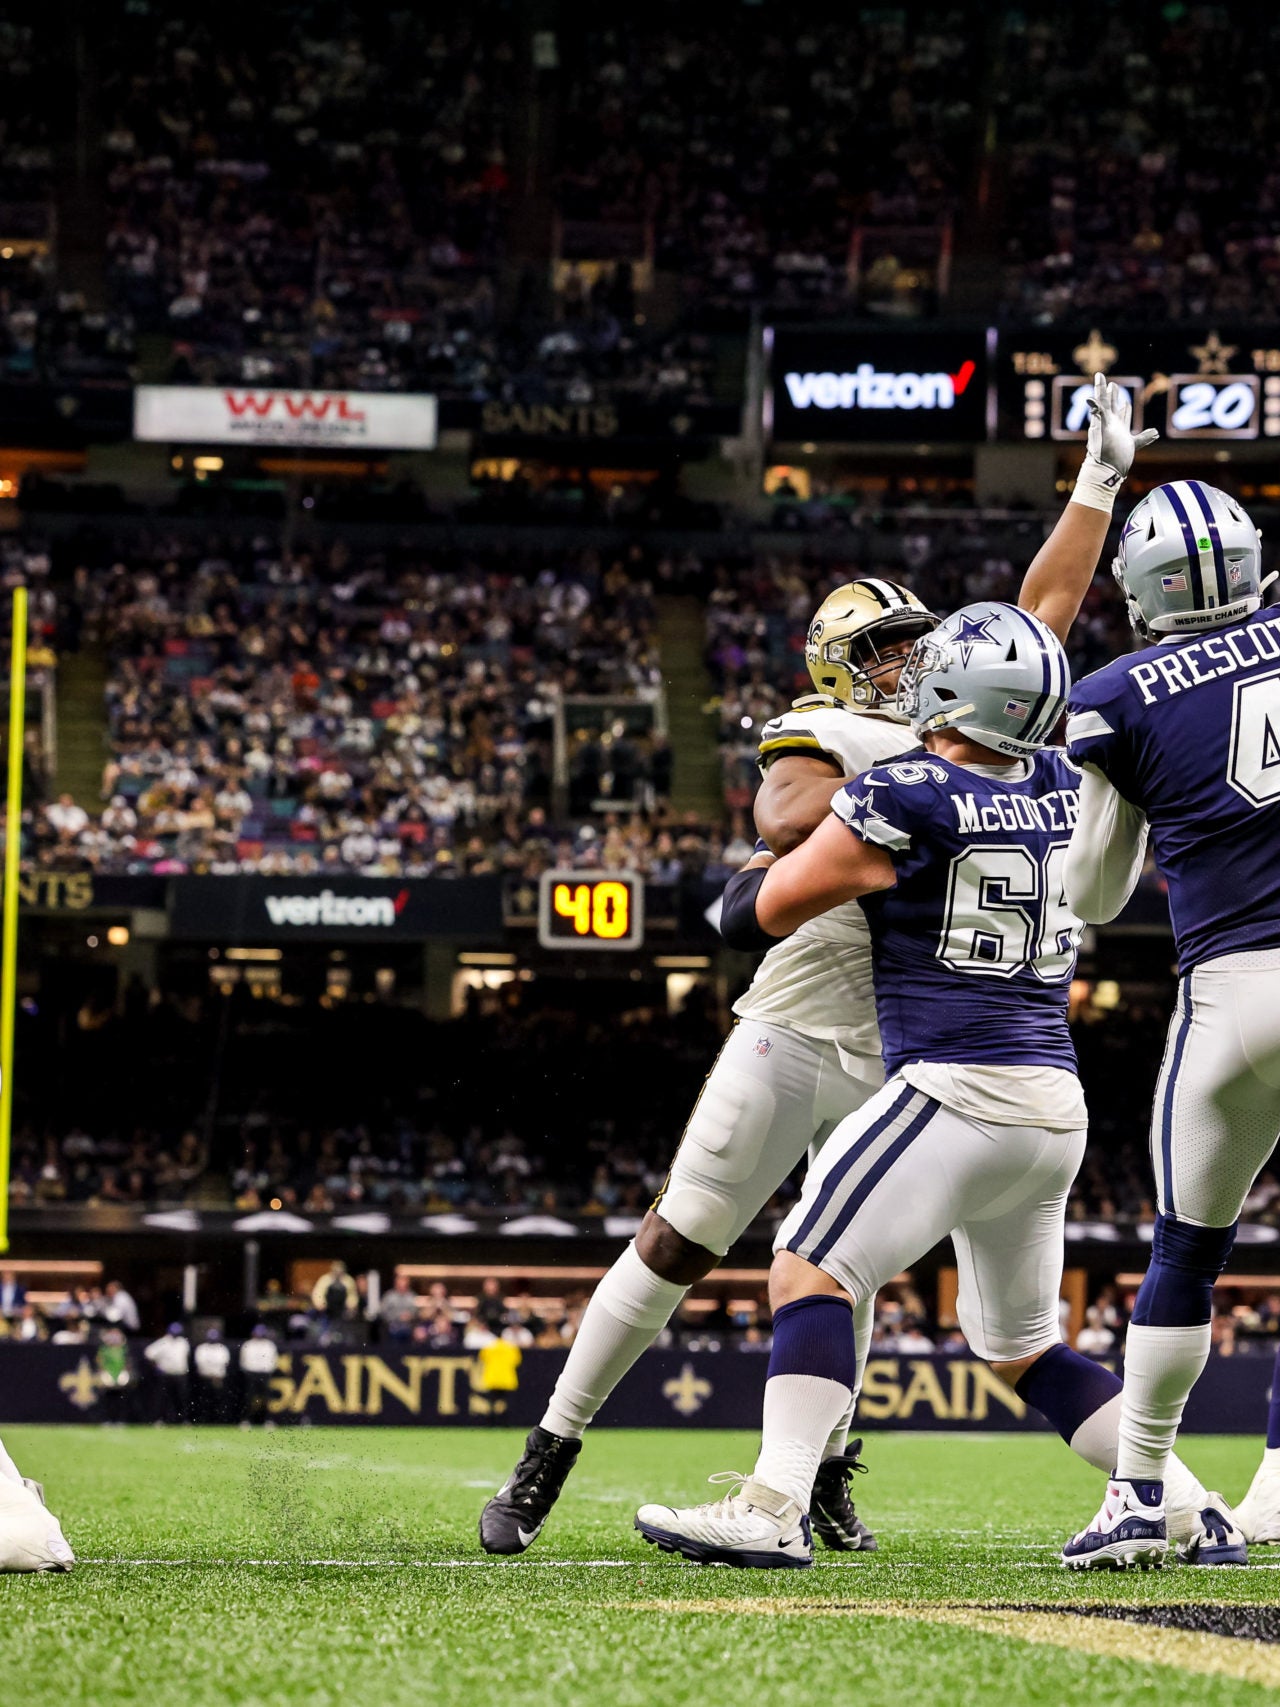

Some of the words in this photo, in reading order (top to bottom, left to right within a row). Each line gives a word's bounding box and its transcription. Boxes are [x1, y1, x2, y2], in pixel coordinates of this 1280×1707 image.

[222, 390, 366, 421] WWL
[785, 364, 955, 409] verizon
[1171, 382, 1256, 431] 20
[482, 401, 619, 435] SAINTS
[1174, 614, 1212, 626] INSPIRE
[1214, 603, 1248, 621] CHANGE
[950, 788, 1080, 834] McGOVER
[265, 890, 395, 926] verizon
[554, 881, 629, 940] 40
